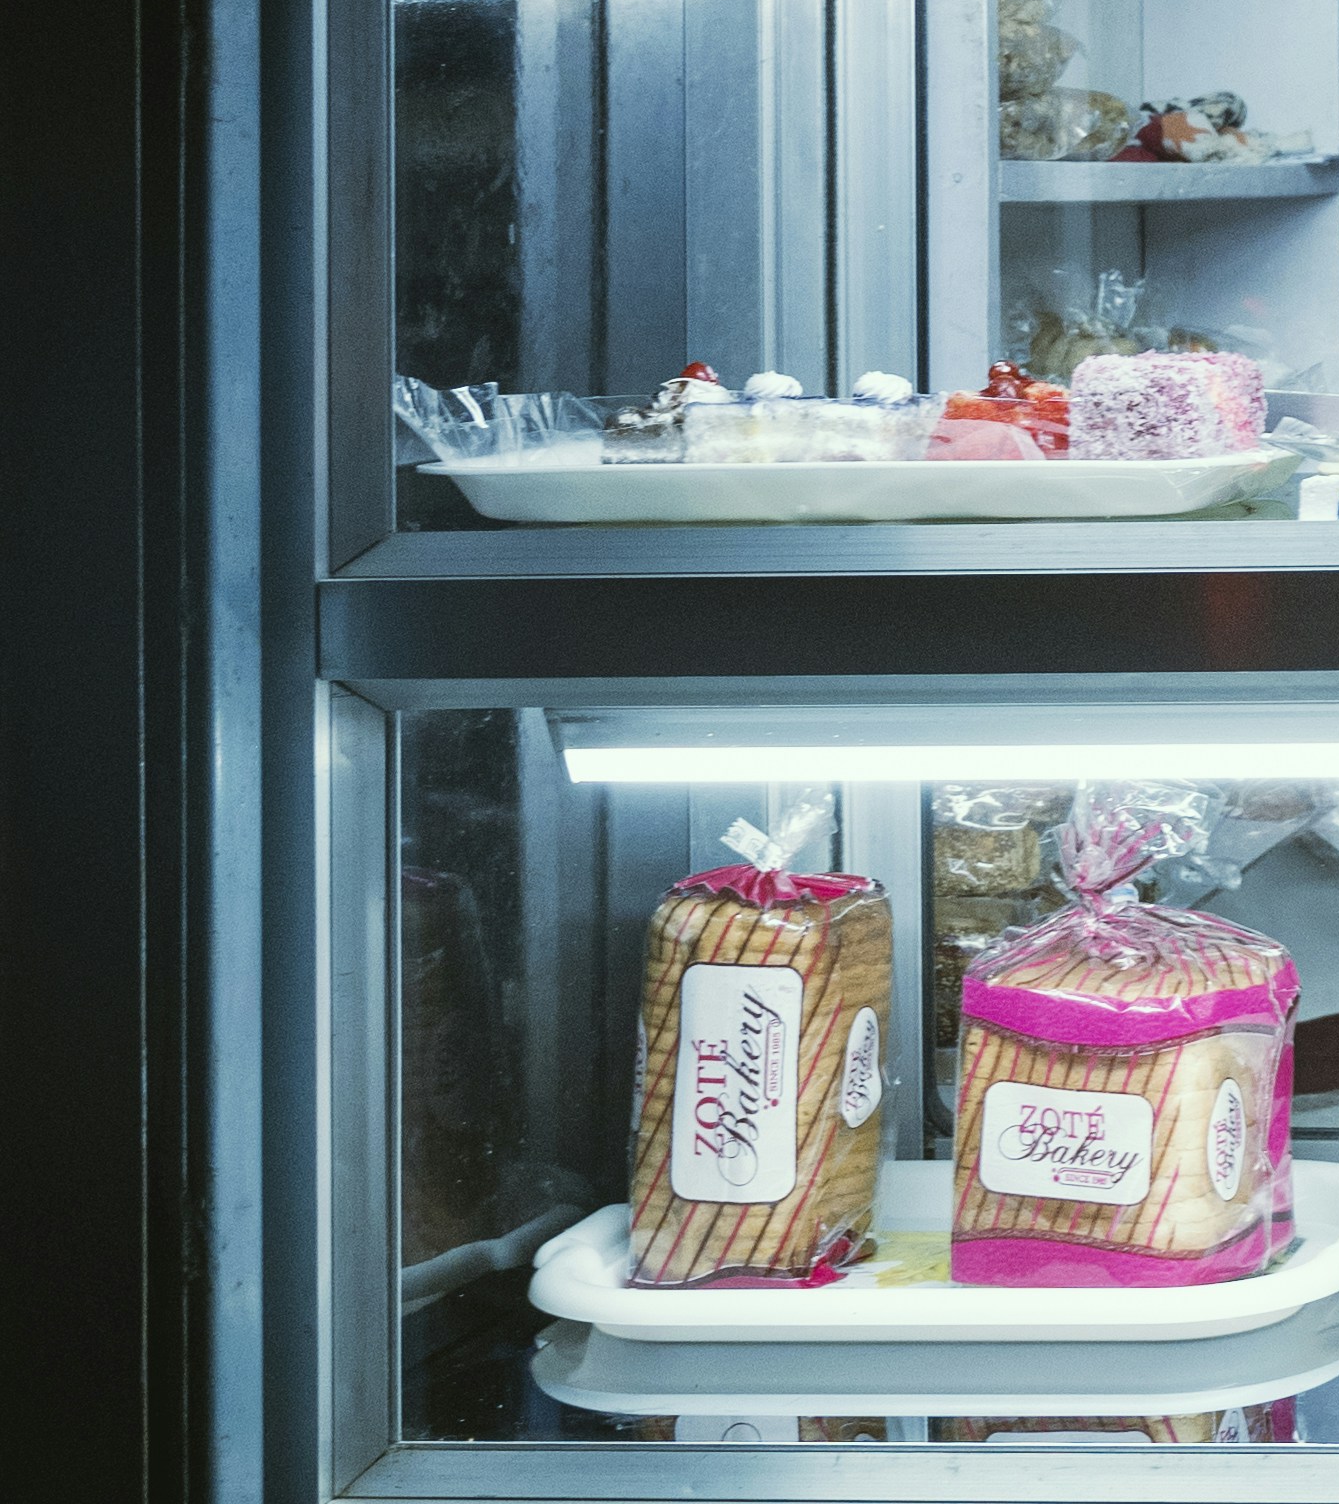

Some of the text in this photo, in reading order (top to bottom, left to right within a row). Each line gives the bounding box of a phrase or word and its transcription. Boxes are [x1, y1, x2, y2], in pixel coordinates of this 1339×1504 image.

[691, 1039, 728, 1158] ZOTÉ
[716, 985, 782, 1187] Bakery
[1018, 1105, 1106, 1141] ZOTÉ
[998, 1123, 1144, 1184] Bakery
